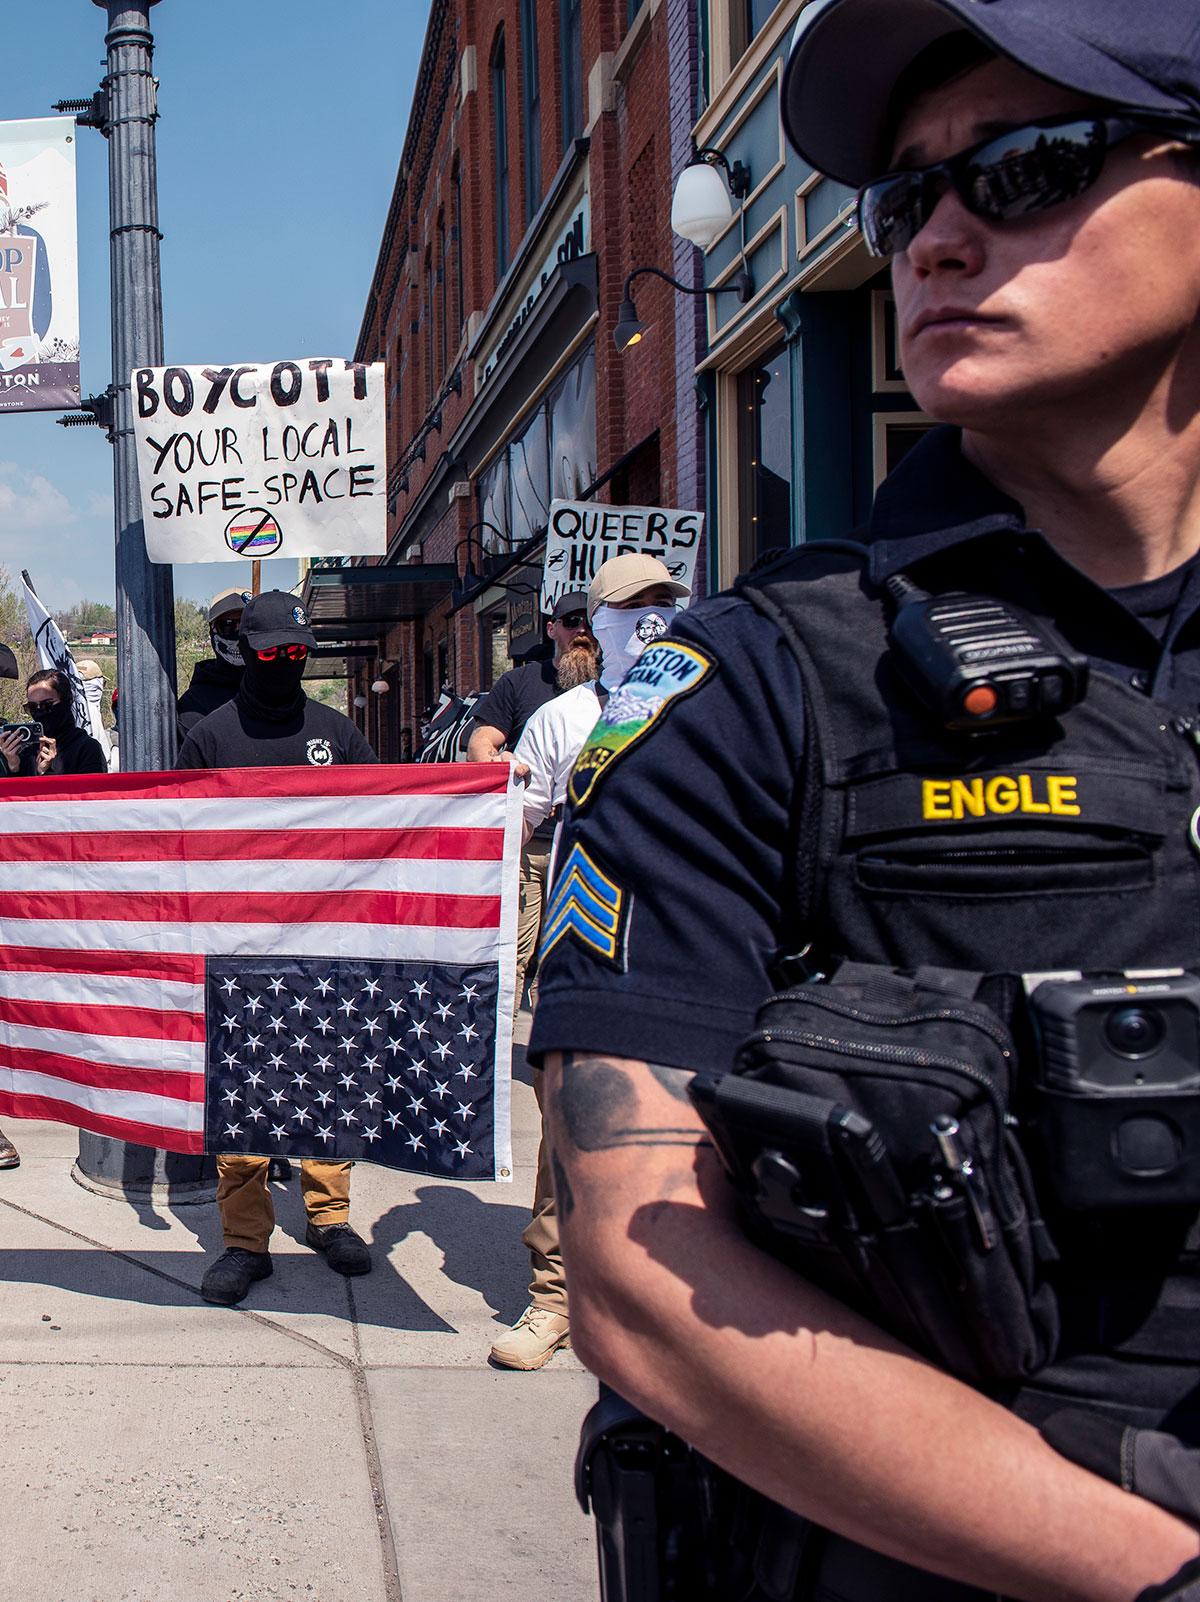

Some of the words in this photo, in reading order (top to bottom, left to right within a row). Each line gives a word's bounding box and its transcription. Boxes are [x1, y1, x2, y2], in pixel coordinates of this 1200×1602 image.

[136, 359, 373, 418] BOYCOTT
[145, 427, 243, 475] YOUR
[262, 417, 365, 462] LOCAL
[151, 464, 375, 519] SAFE-SPACE
[553, 508, 698, 548] QUEERS
[569, 543, 666, 581] HUT
[922, 774, 1081, 820] ENGLE
